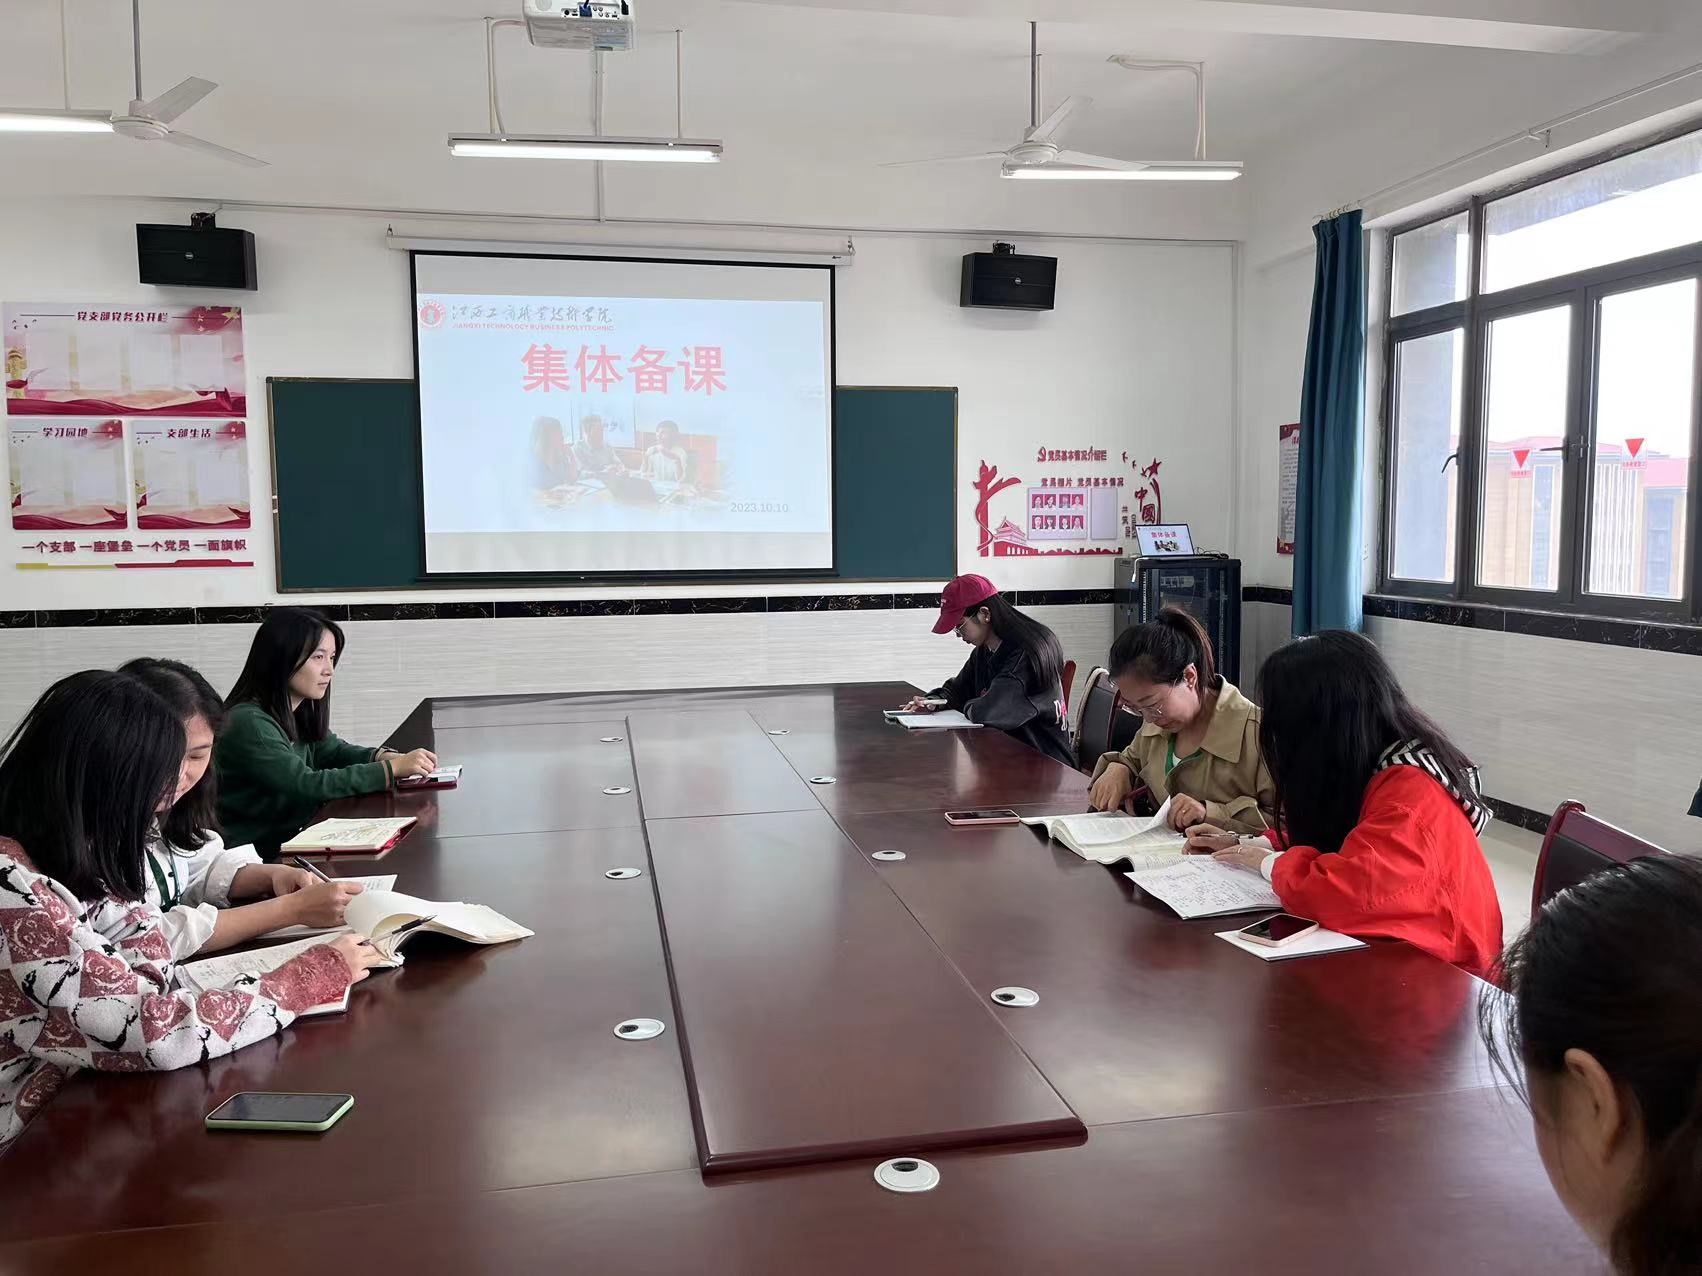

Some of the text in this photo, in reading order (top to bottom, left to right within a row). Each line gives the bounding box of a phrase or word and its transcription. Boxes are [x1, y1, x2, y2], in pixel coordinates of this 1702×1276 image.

[77, 311, 168, 323] 党支部党务公开栏
[521, 343, 727, 395] 集体备课
[42, 427, 88, 438] 学习园地
[167, 428, 211, 439] 支部生活
[730, 502, 789, 513] 2023.10.10
[22, 539, 247, 553] 一个支部 一座堡垒 一个党员 一面旗帜
